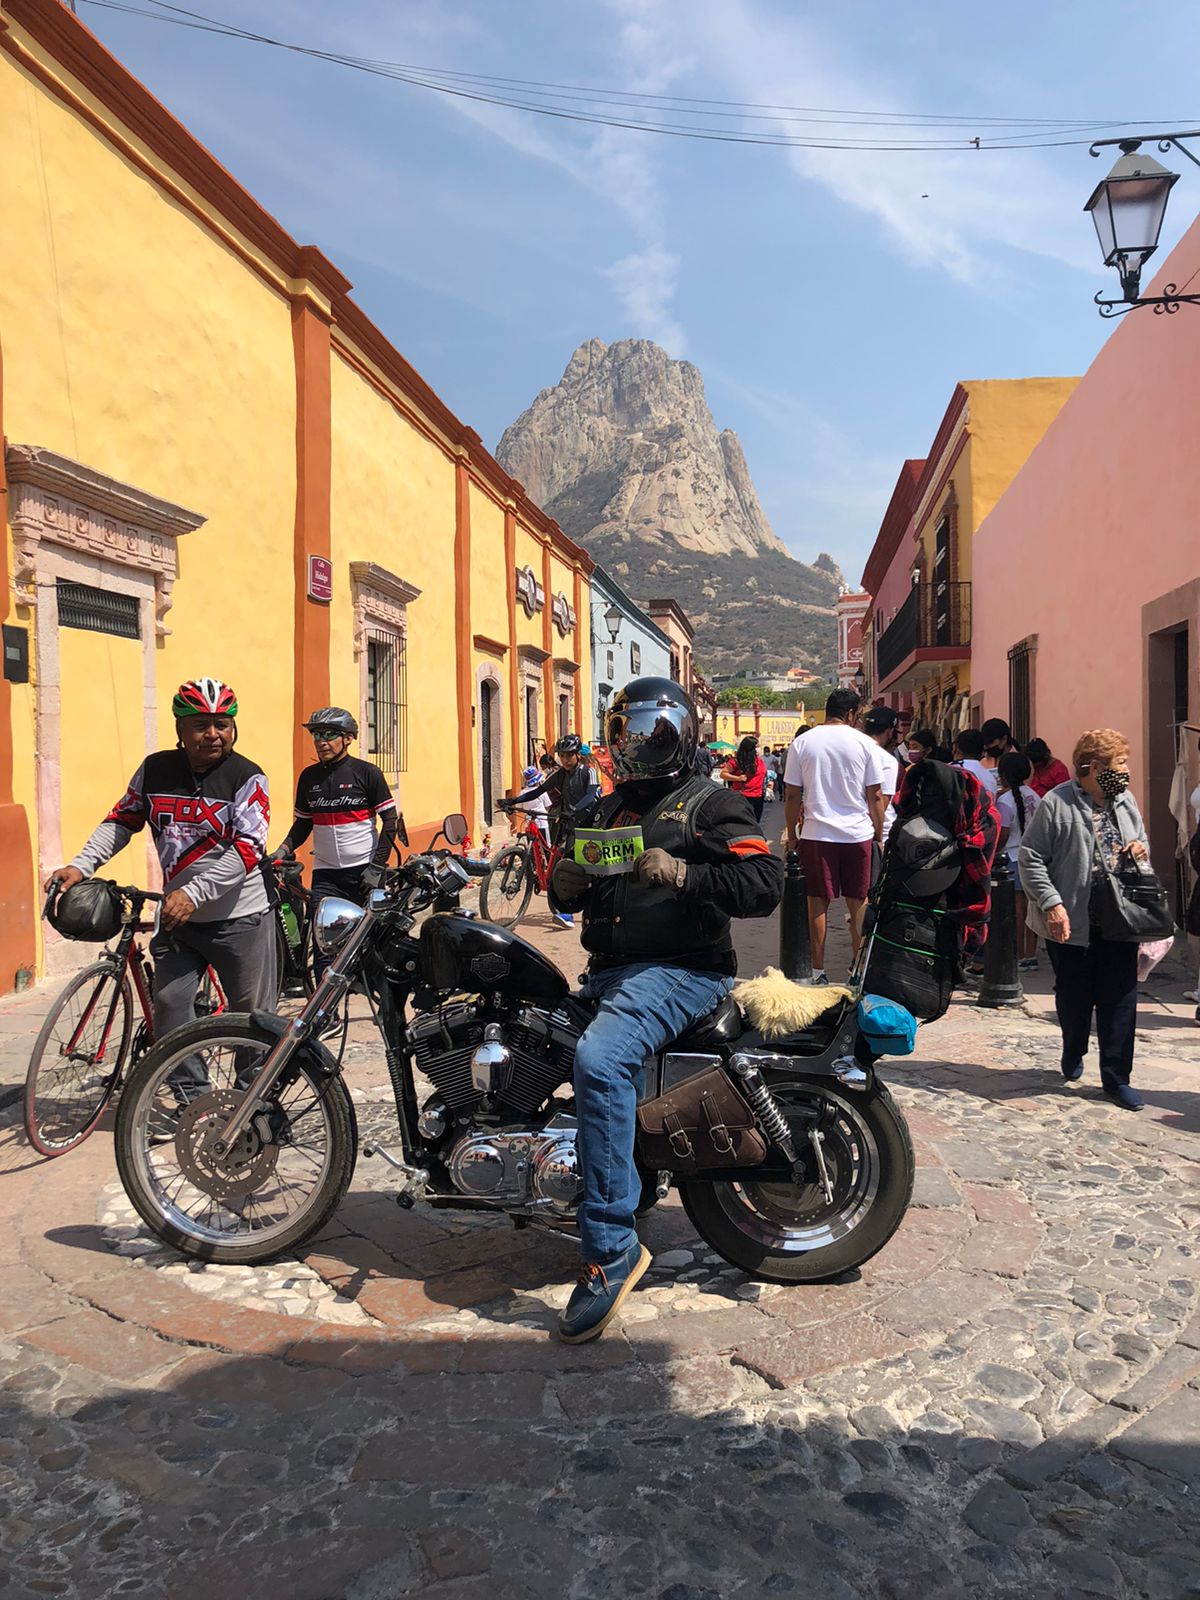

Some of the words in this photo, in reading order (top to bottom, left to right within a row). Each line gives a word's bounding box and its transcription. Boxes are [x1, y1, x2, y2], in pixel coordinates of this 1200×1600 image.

[308, 795, 367, 807] ellwether
[148, 794, 228, 837] FOX
[602, 843, 635, 859] RRM
